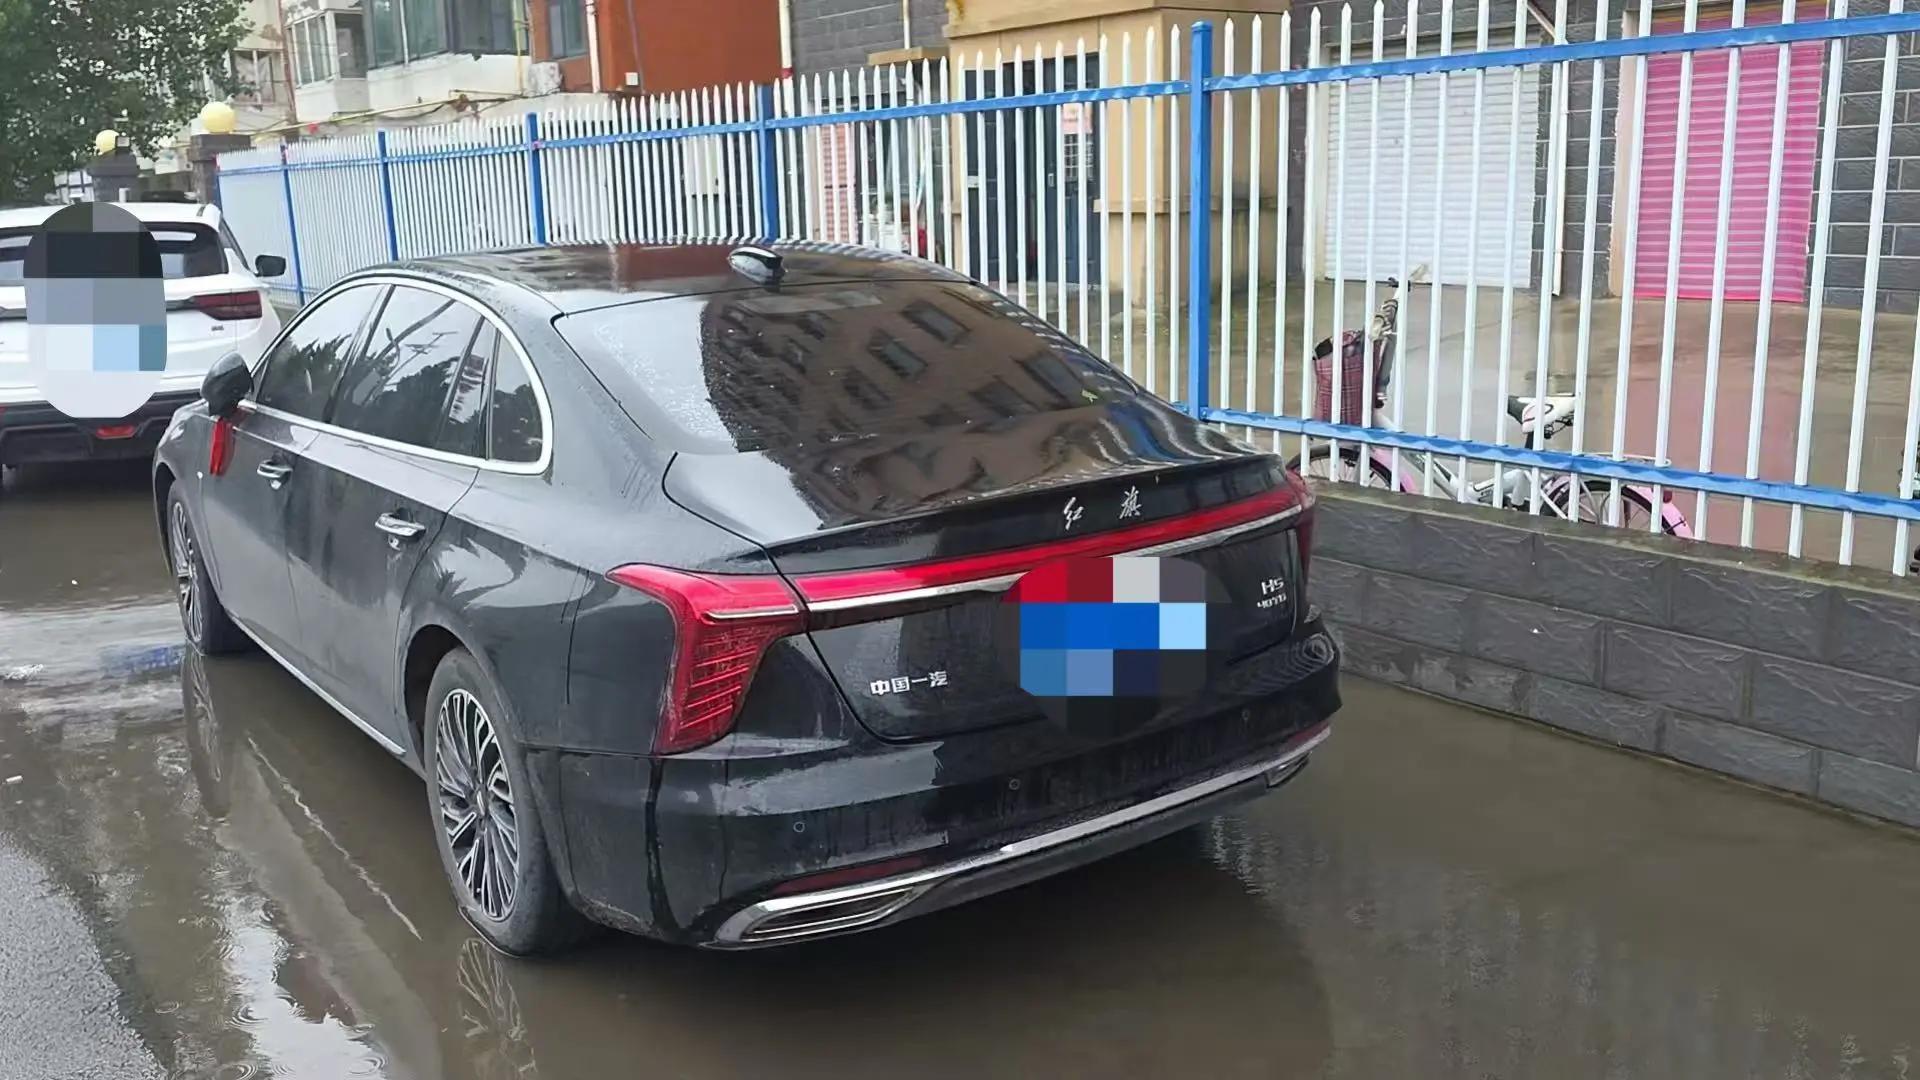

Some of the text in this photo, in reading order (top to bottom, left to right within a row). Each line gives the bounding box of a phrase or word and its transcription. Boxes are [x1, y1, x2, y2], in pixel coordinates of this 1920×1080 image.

[1063, 485, 1142, 531] 红旗
[870, 670, 948, 696] 中国一汽
